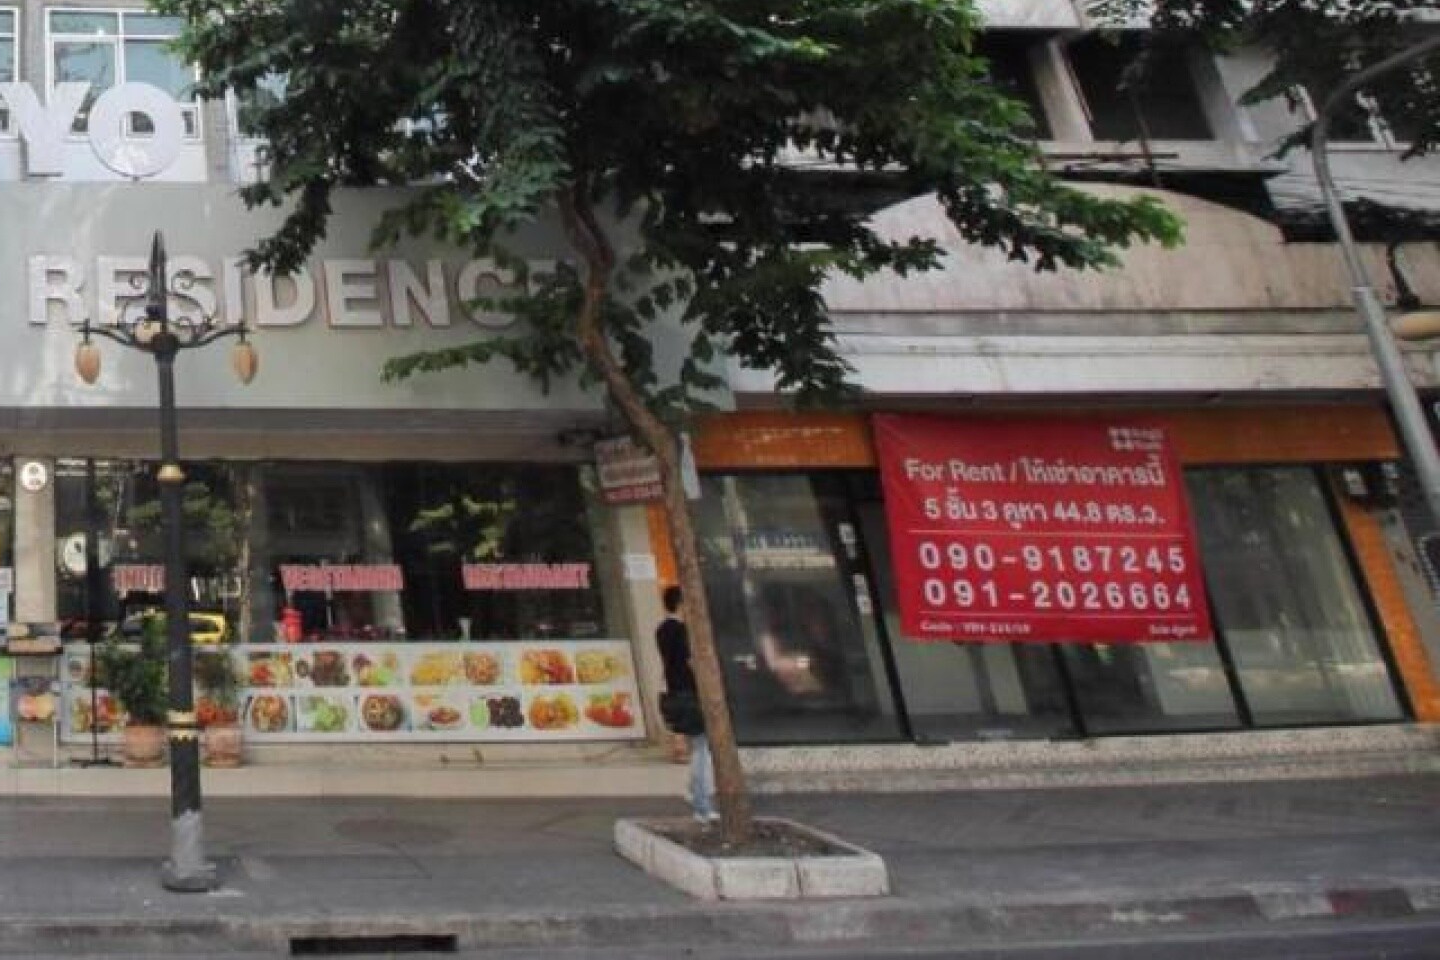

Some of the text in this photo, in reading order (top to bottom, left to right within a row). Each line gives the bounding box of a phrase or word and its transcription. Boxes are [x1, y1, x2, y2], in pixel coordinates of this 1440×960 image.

[904, 458, 944, 481] For
[949, 459, 1006, 482] Rent
[925, 497, 941, 520] 5
[981, 500, 998, 520] 3
[918, 542, 1186, 573] 090-9187245
[924, 579, 1191, 610] 091-2026664
